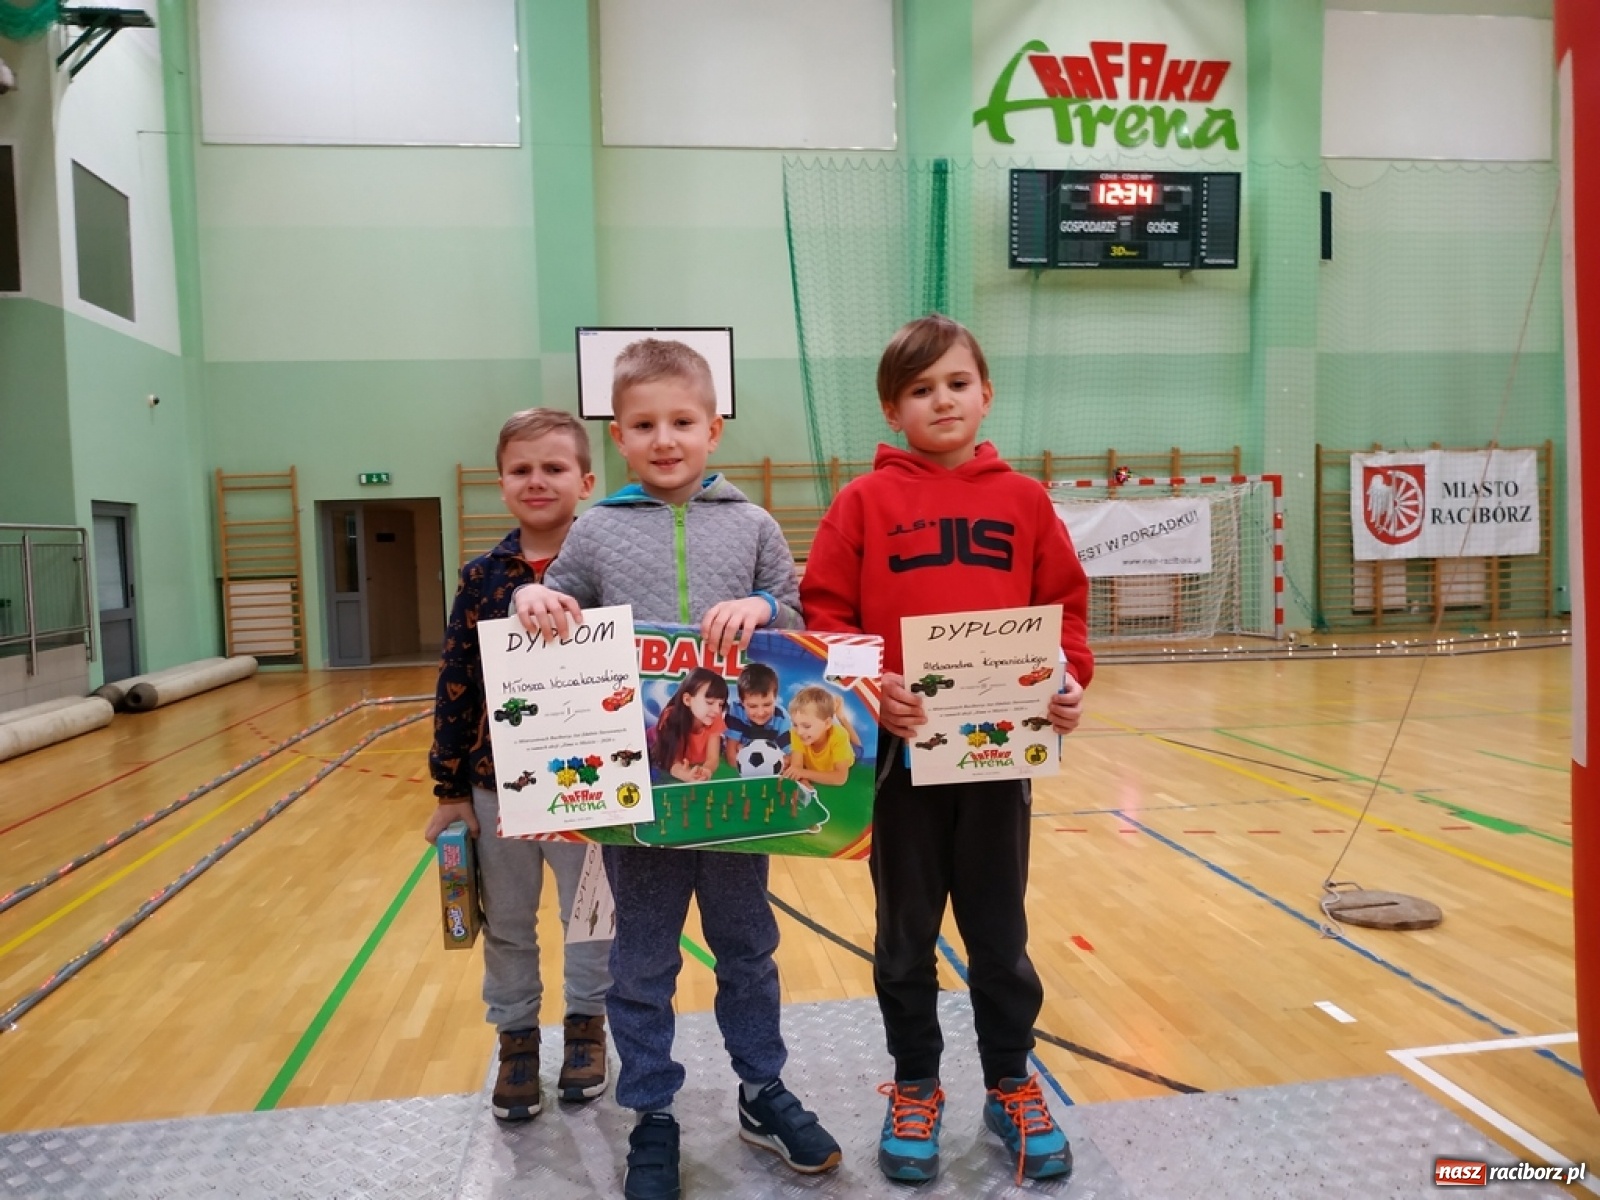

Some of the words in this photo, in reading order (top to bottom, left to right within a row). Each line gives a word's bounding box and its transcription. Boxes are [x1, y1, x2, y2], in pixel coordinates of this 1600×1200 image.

[1028, 41, 1231, 102] RAFAKO
[973, 40, 1239, 150] Arena
[1060, 221, 1118, 233] GOSPODARZE
[1146, 218, 1179, 233] GOŚCIE
[1442, 480, 1519, 499] MIASTO
[1431, 501, 1532, 525] RACIBÓRZ
[1105, 537, 1119, 551] W
[1122, 510, 1198, 547] PORZĄDKU!
[889, 518, 1015, 573] JLS
[928, 616, 1042, 641] DYPLOM
[635, 638, 743, 676] BALL
[956, 751, 1014, 769] Arena
[547, 792, 606, 814] Arena
